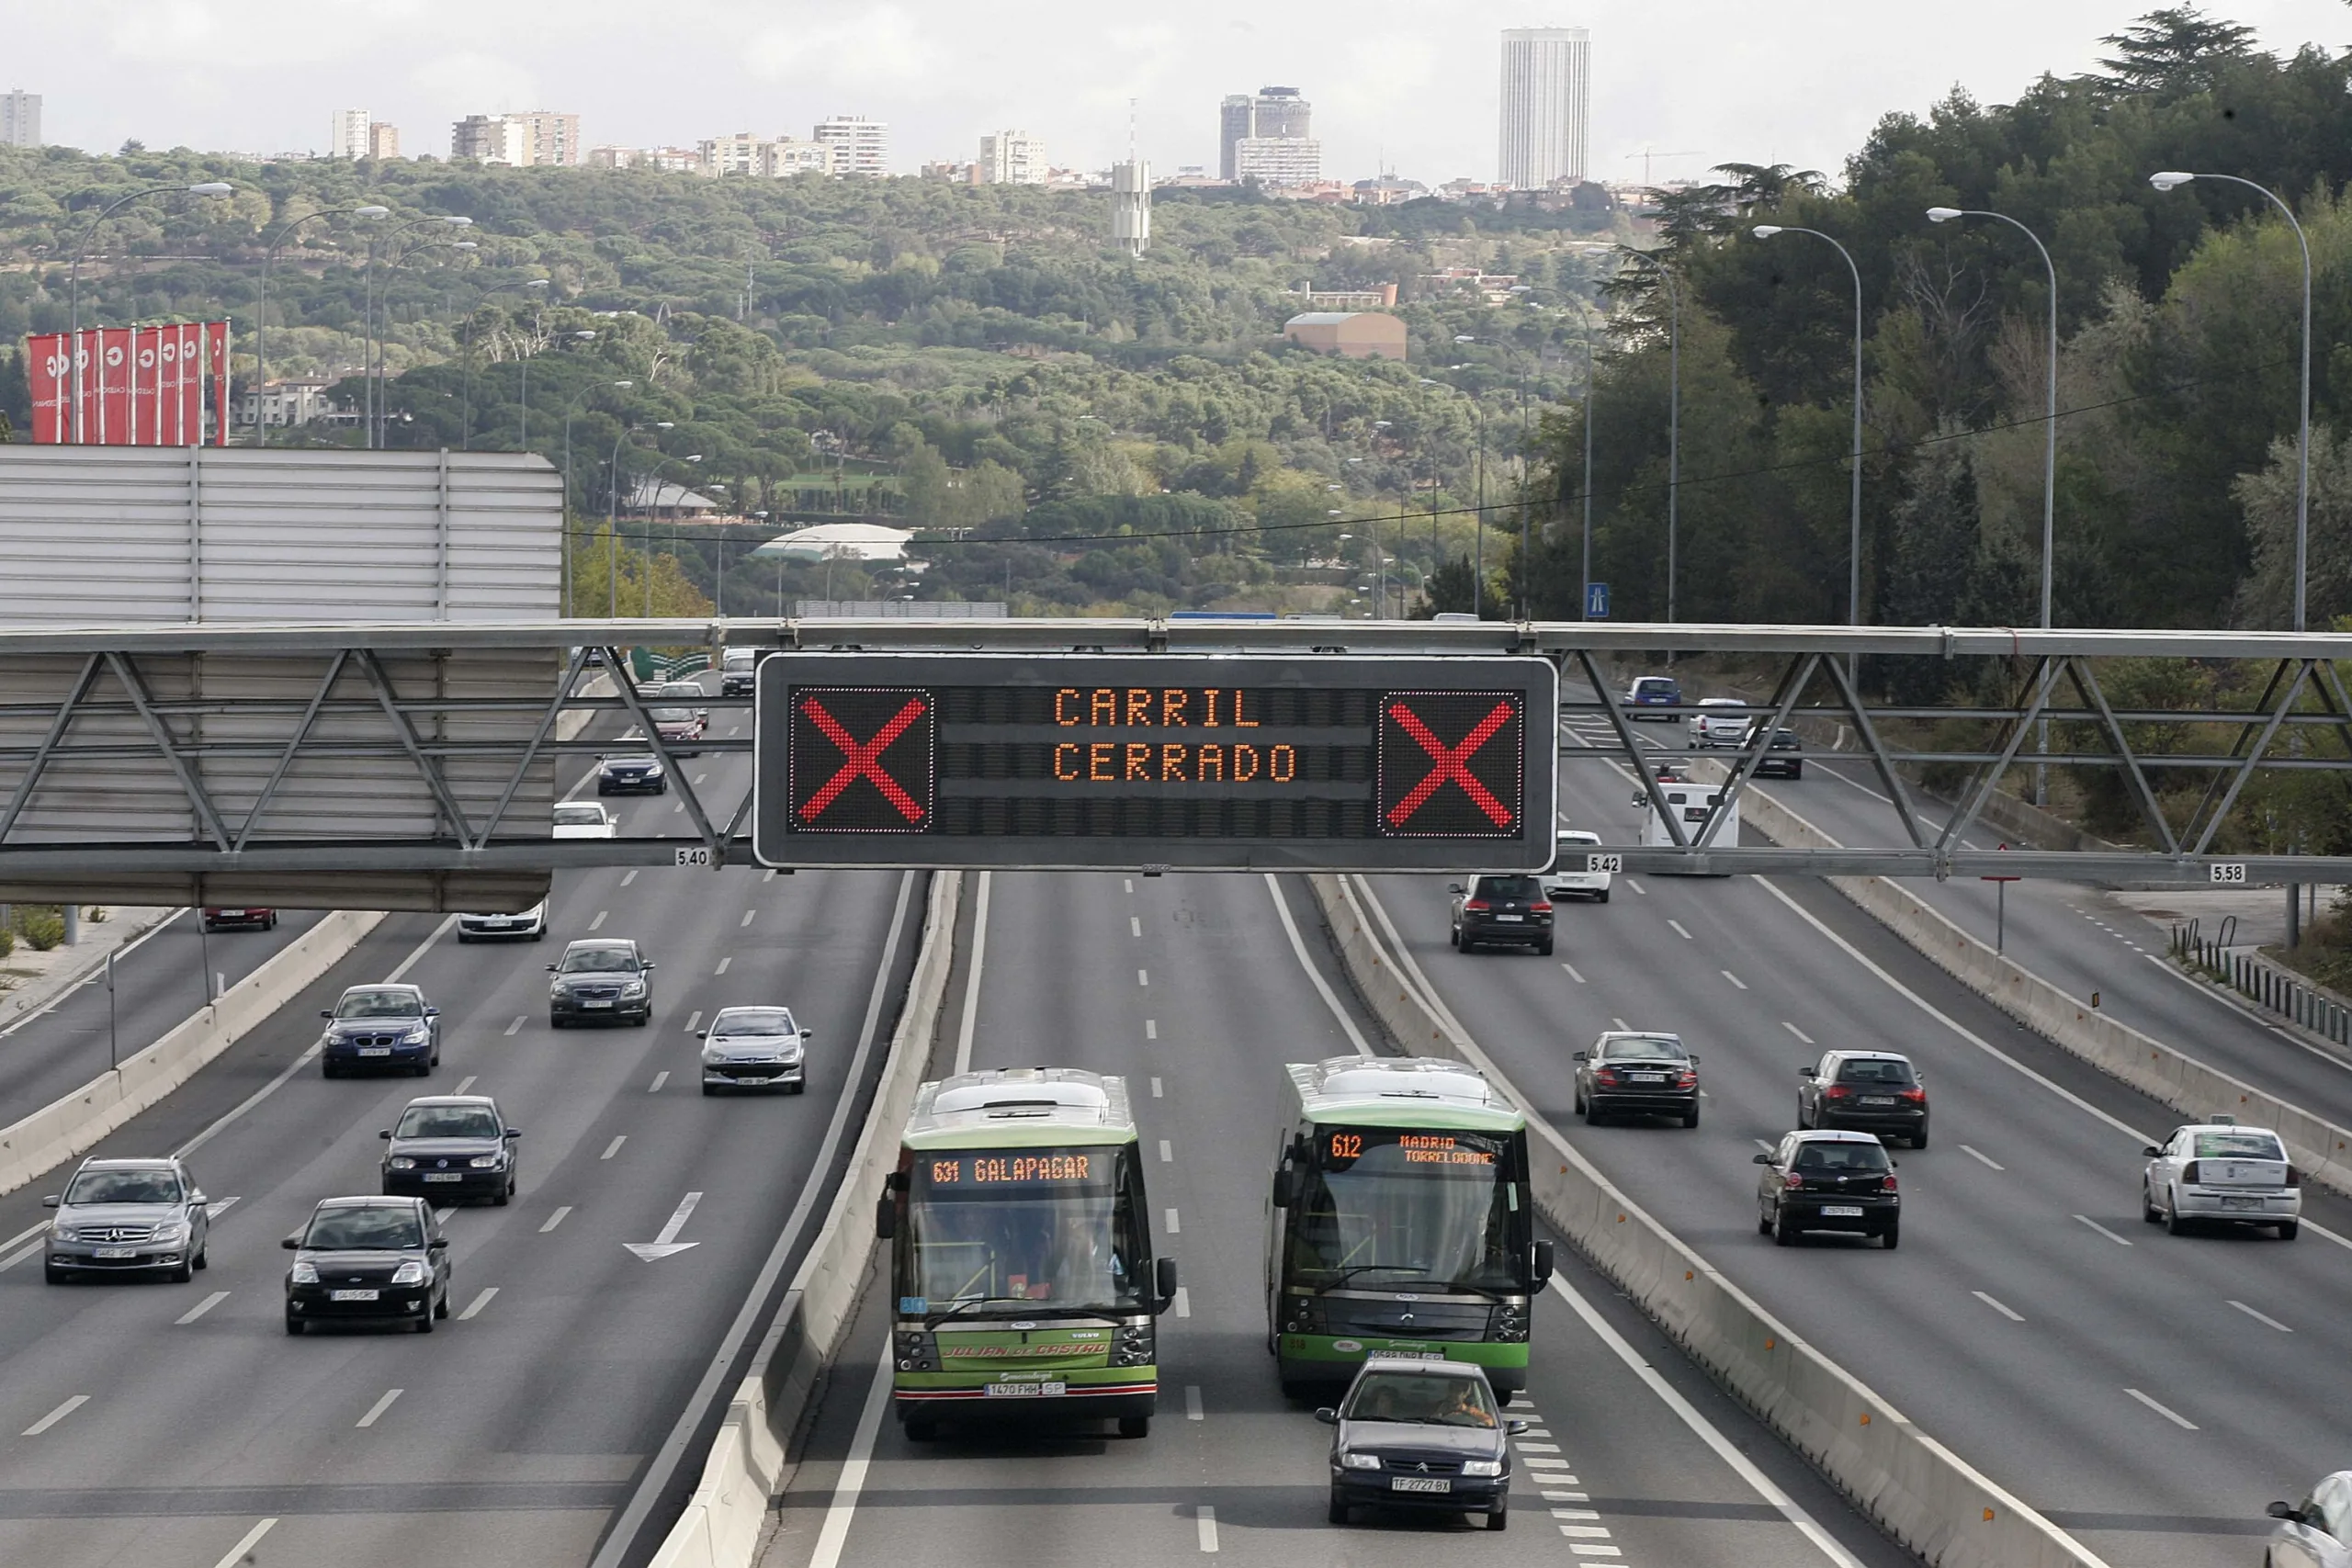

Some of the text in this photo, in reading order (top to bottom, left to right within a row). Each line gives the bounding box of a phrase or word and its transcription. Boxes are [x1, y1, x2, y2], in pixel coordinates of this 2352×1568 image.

[1056, 689, 1259, 728] CARRIL
[1055, 743, 1295, 782] CERRADO
[678, 851, 707, 866] 5,40
[1590, 857, 1619, 873] 5,42
[2214, 865, 2243, 881] 5,58
[1332, 1134, 1362, 1157] 612
[1399, 1135, 1455, 1150] MADRID
[933, 1156, 1089, 1182] 631 GALAPAGAR
[992, 1383, 1037, 1394] 1470 FHH
[1045, 1383, 1063, 1393] SP
